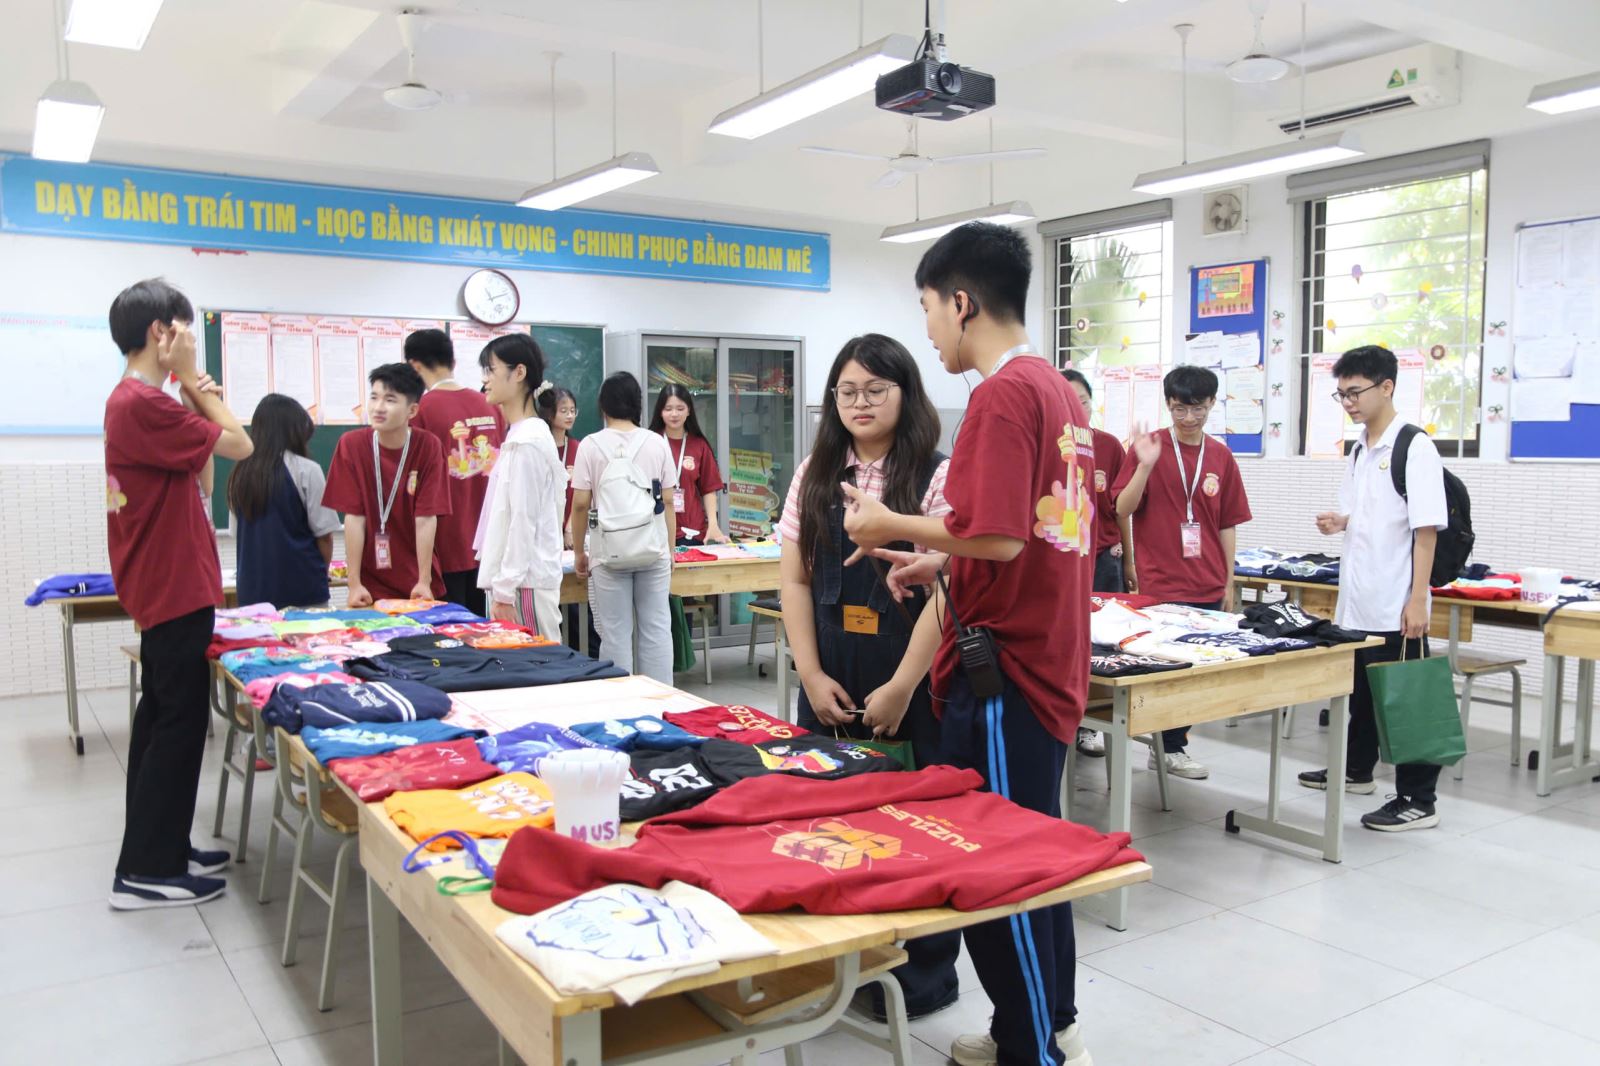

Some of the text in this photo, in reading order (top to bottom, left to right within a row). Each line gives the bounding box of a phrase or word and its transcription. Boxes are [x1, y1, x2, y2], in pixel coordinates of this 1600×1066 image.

[35, 181, 94, 222] DẠY
[102, 178, 179, 224] BẰNG
[183, 192, 244, 230] TRÁI
[250, 201, 297, 233] TIM
[317, 207, 366, 243] HỌC
[371, 203, 434, 243] BẰNG
[438, 214, 496, 248] KHÁT
[501, 223, 557, 256] VỌNG
[572, 229, 634, 259] CHINH
[638, 234, 689, 267] PHỤC
[692, 232, 741, 268] BẰNG
[744, 245, 783, 271] ĐAM
[787, 245, 812, 274] MÊ
[877, 804, 982, 853] PUZZLES
